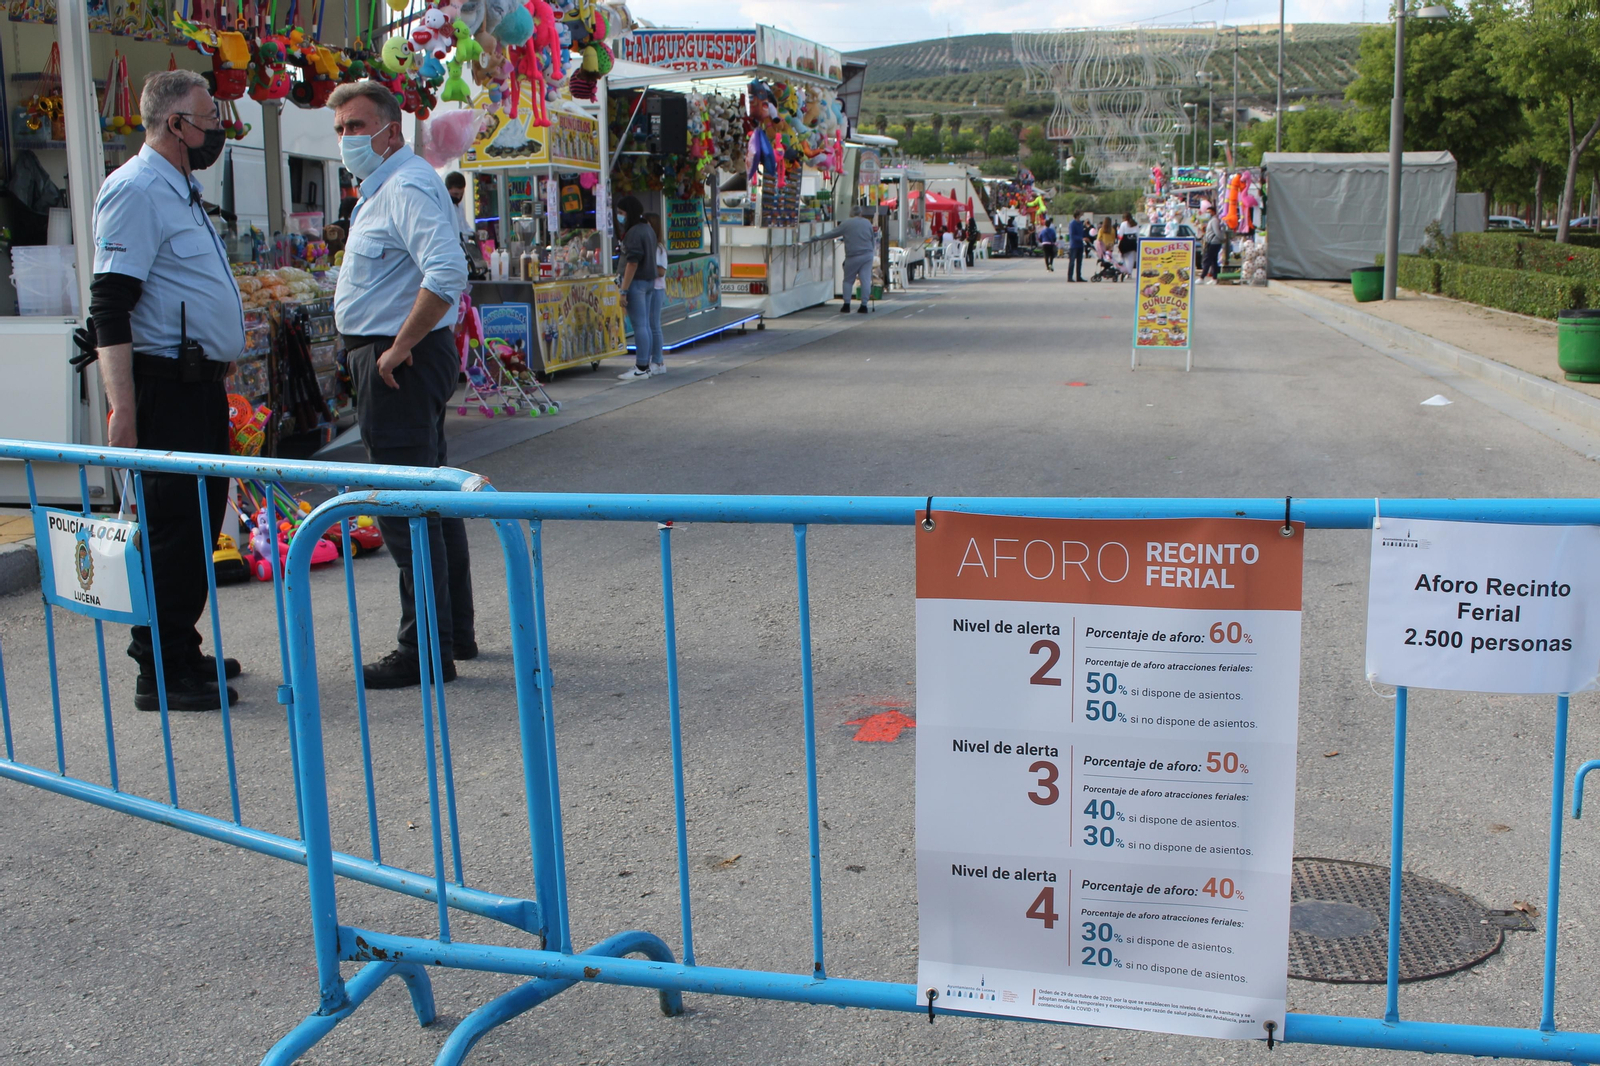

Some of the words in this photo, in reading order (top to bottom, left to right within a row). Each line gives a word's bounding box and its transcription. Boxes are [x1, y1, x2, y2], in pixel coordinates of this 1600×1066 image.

[625, 34, 757, 66] HAMBURGUESERIA
[668, 231, 686, 239] PIDA
[688, 230, 701, 238] LOS
[671, 240, 700, 249] PUNTOS
[1142, 295, 1188, 311] BUÑUELOS
[90, 524, 126, 542] LOCAL
[957, 537, 1130, 583] AFORO
[1146, 541, 1260, 565] RECINTO
[1146, 566, 1235, 589] FERIAL
[1414, 573, 1478, 594] Aforo
[1486, 577, 1572, 598] Recinto
[74, 590, 101, 606] LUCENA
[1458, 602, 1520, 622] Ferial
[953, 619, 990, 632] Nivel
[994, 620, 1013, 634] de
[1016, 621, 1060, 636] alerta
[1085, 627, 1149, 642] Porcentaje
[1152, 630, 1166, 642] de
[1169, 632, 1205, 644] aforo:
[1209, 621, 1253, 644] 60%
[1404, 628, 1463, 648] 2.500
[1470, 635, 1573, 654] personas
[1029, 639, 1062, 687] 2
[1085, 658, 1130, 668] Porcentaje
[1130, 660, 1141, 668] de
[1143, 662, 1166, 670] aforo
[1167, 663, 1216, 672] atracciones
[1218, 664, 1253, 672] feriales:
[1086, 672, 1128, 696] 50%
[1130, 688, 1140, 696] si
[1142, 688, 1181, 699] dispone
[1184, 690, 1196, 698] de
[1198, 690, 1244, 700] asientos.
[1085, 700, 1127, 722] 50%
[1130, 715, 1139, 724] si
[1156, 716, 1196, 728] dispone
[1198, 717, 1210, 726] de
[1212, 718, 1258, 728] asientos.
[952, 739, 989, 753] Nivel
[994, 741, 1012, 754] de
[1016, 742, 1058, 758] alerta
[1084, 756, 1146, 771] Porcentaje
[1149, 760, 1164, 770] de
[1166, 760, 1202, 772] aforo:
[1206, 752, 1249, 774] 50%
[1028, 760, 1060, 806] 3
[1083, 784, 1126, 796] Porcentaje
[1140, 788, 1162, 798] aforo
[1164, 790, 1212, 800] atracciones
[1214, 792, 1249, 802] feriales:
[1084, 798, 1126, 822] 40%
[1128, 814, 1136, 823] si
[1139, 815, 1178, 826] dispone
[1180, 817, 1192, 826] de
[1195, 818, 1240, 828] asientos.
[1083, 824, 1124, 848] 30%
[1128, 840, 1136, 850] si
[1154, 842, 1192, 854] dispone
[1194, 844, 1207, 854] de
[1209, 846, 1254, 856] asientos.
[952, 864, 988, 878] Nivel
[992, 866, 1010, 880] de
[1014, 868, 1056, 882] alerta
[1082, 880, 1144, 895] Porcentaje
[1146, 884, 1160, 894] de
[1164, 884, 1198, 896] aforo:
[1202, 877, 1244, 900] 40%
[1026, 886, 1059, 929] 4
[1080, 908, 1124, 920] Porcentaje
[1138, 912, 1160, 920] aforo
[1162, 914, 1209, 924] atracciones
[1210, 916, 1244, 928] feriales:
[1082, 922, 1123, 943] 30%
[1126, 936, 1134, 944] si
[1137, 936, 1174, 948] dispone
[1178, 940, 1190, 948] de
[1192, 941, 1234, 954] asientos.
[1081, 946, 1122, 968] 20%
[1126, 961, 1134, 970] si
[1150, 964, 1188, 976] dispone
[1190, 968, 1202, 977] de
[1204, 970, 1248, 984] asientos.
[1219, 1009, 1239, 1017] sanitaria
